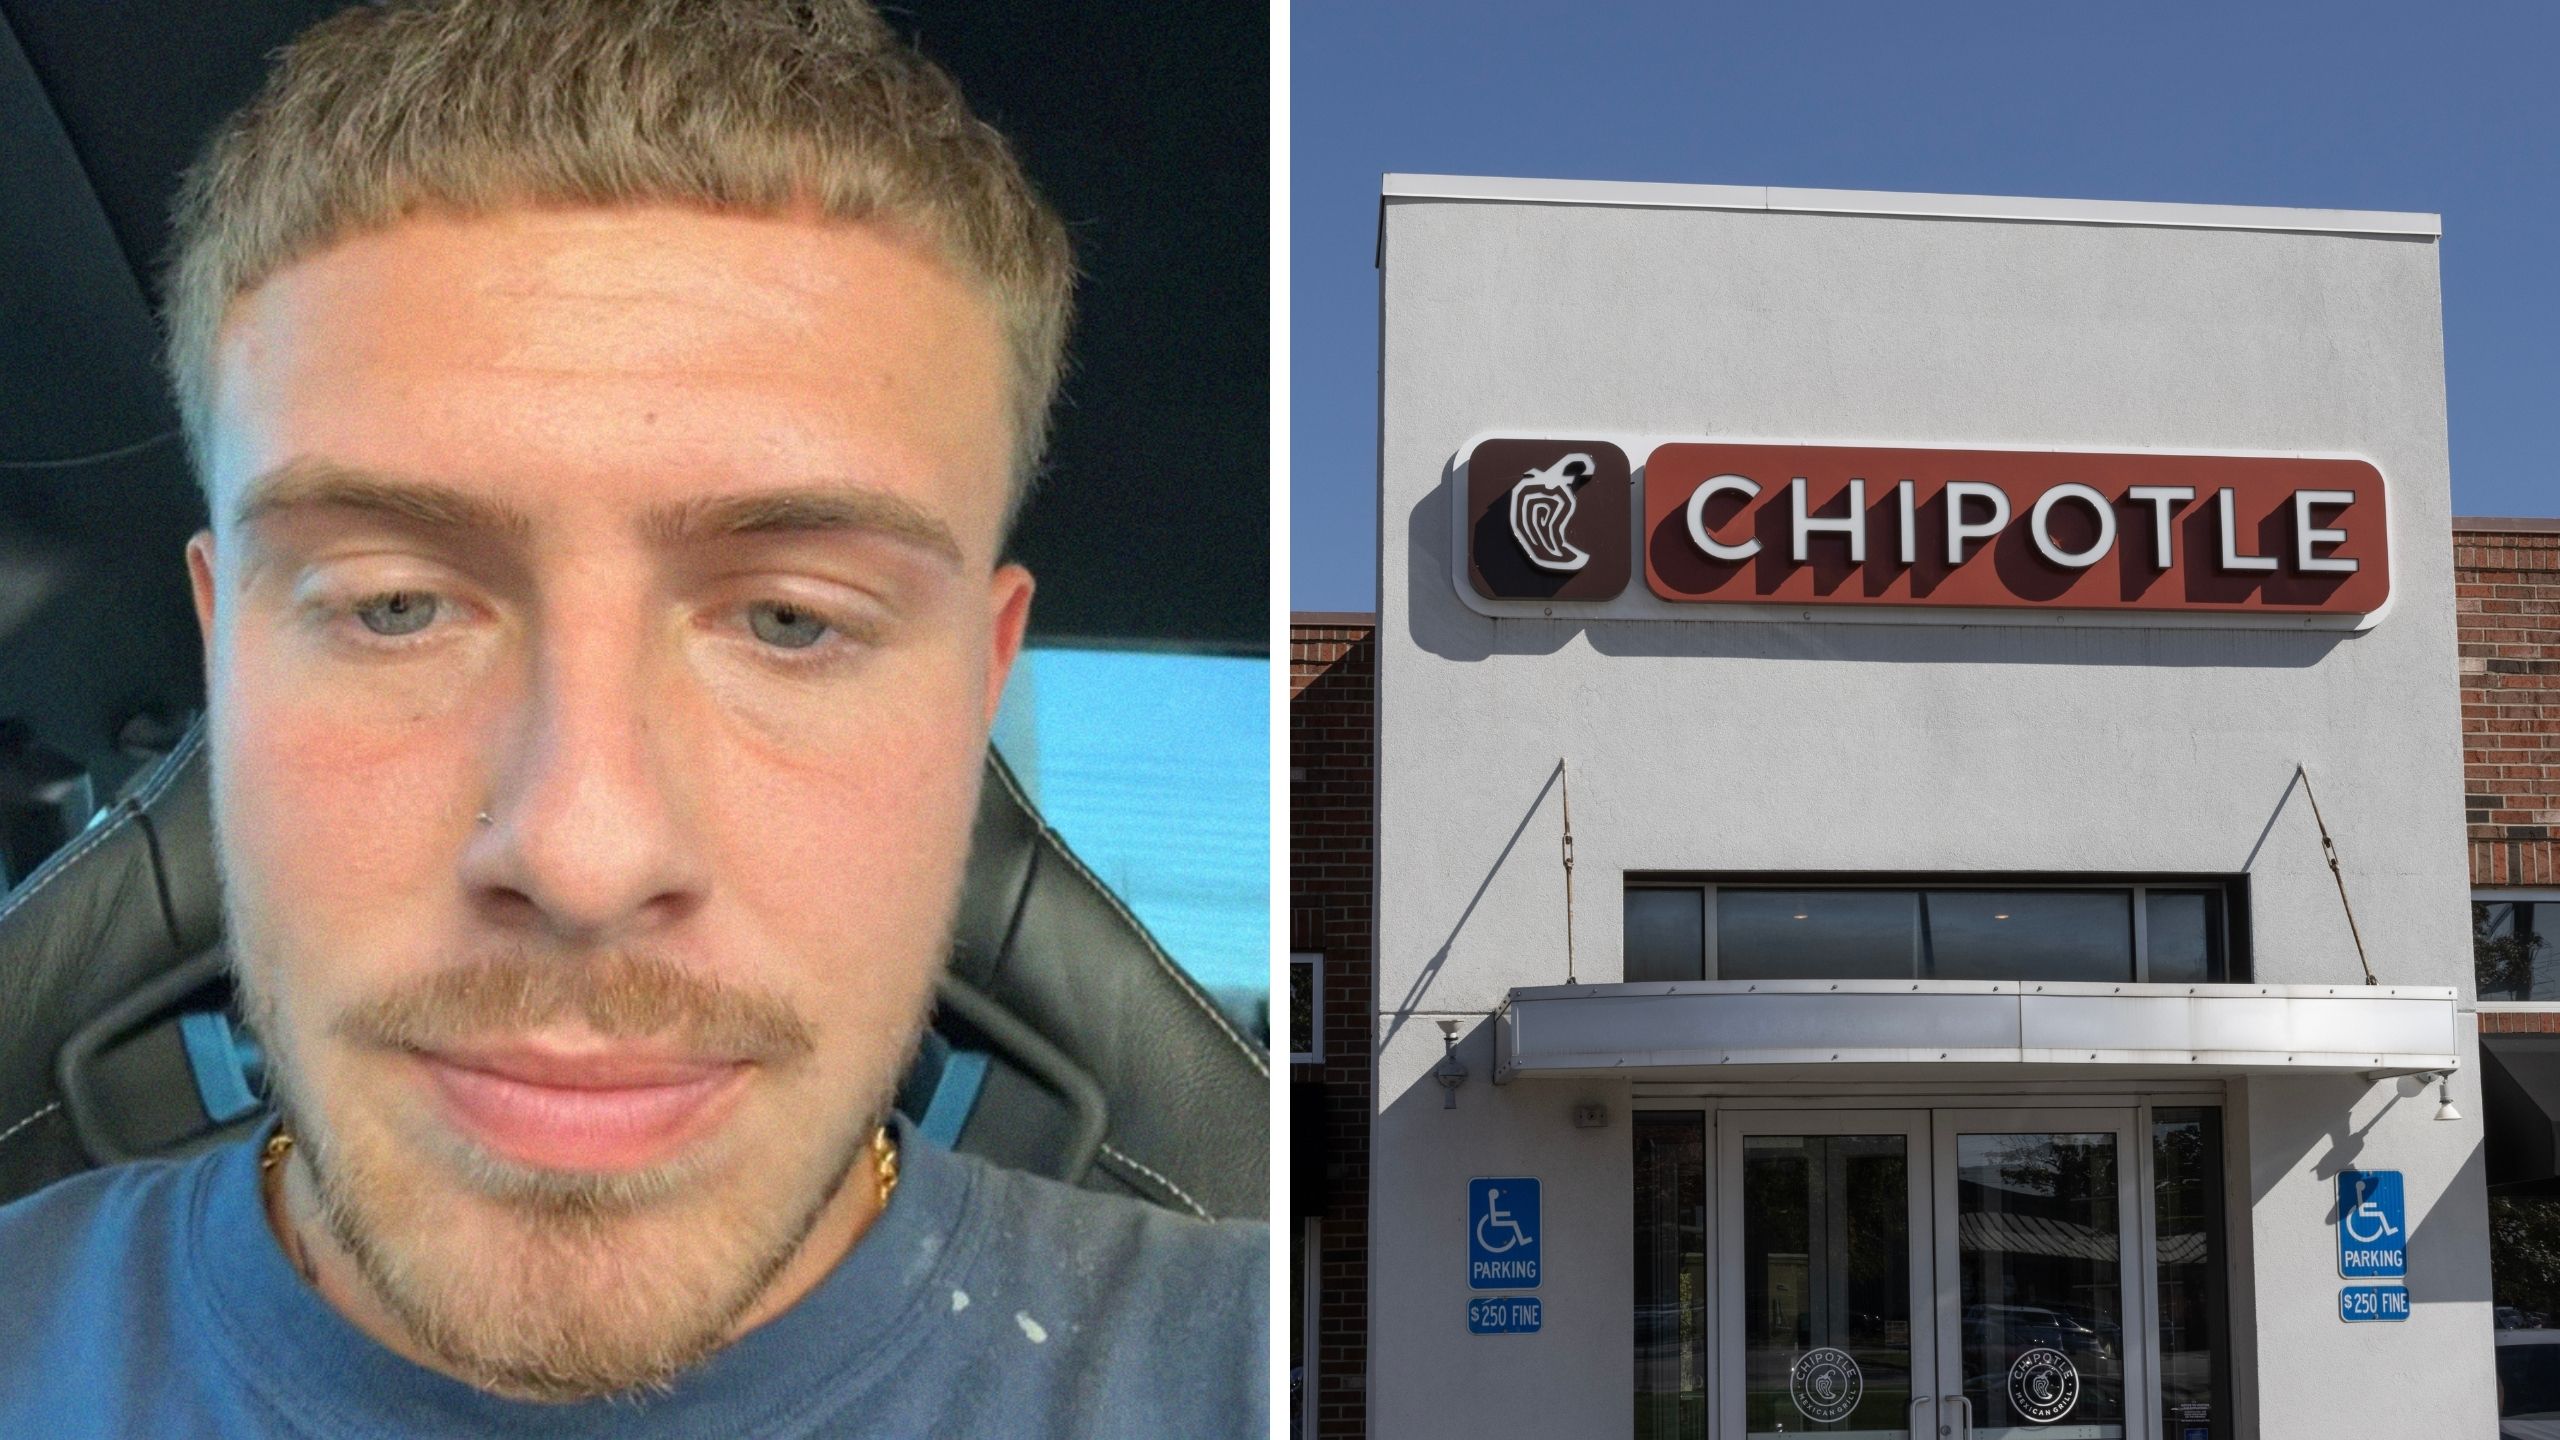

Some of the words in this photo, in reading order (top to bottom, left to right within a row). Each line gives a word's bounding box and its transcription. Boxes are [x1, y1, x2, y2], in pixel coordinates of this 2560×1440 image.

[1686, 474, 2359, 572] CHIPOTLE
[1473, 1261, 1537, 1279] PARKING
[2344, 1250, 2403, 1267] PARKING
[1470, 1305, 1507, 1326] $250
[1512, 1305, 1539, 1325] FINE
[2344, 1293, 2378, 1313] $250
[2382, 1293, 2408, 1313] FINE
[1796, 1352, 1856, 1380] CHIPOTLE
[2014, 1353, 2073, 1379] CHIPOTLE
[1799, 1393, 1835, 1416] MEXICAN
[1837, 1389, 1856, 1413] GRILL
[2015, 1392, 2051, 1416] MEXICAN
[2053, 1391, 2073, 1413] GRILL
